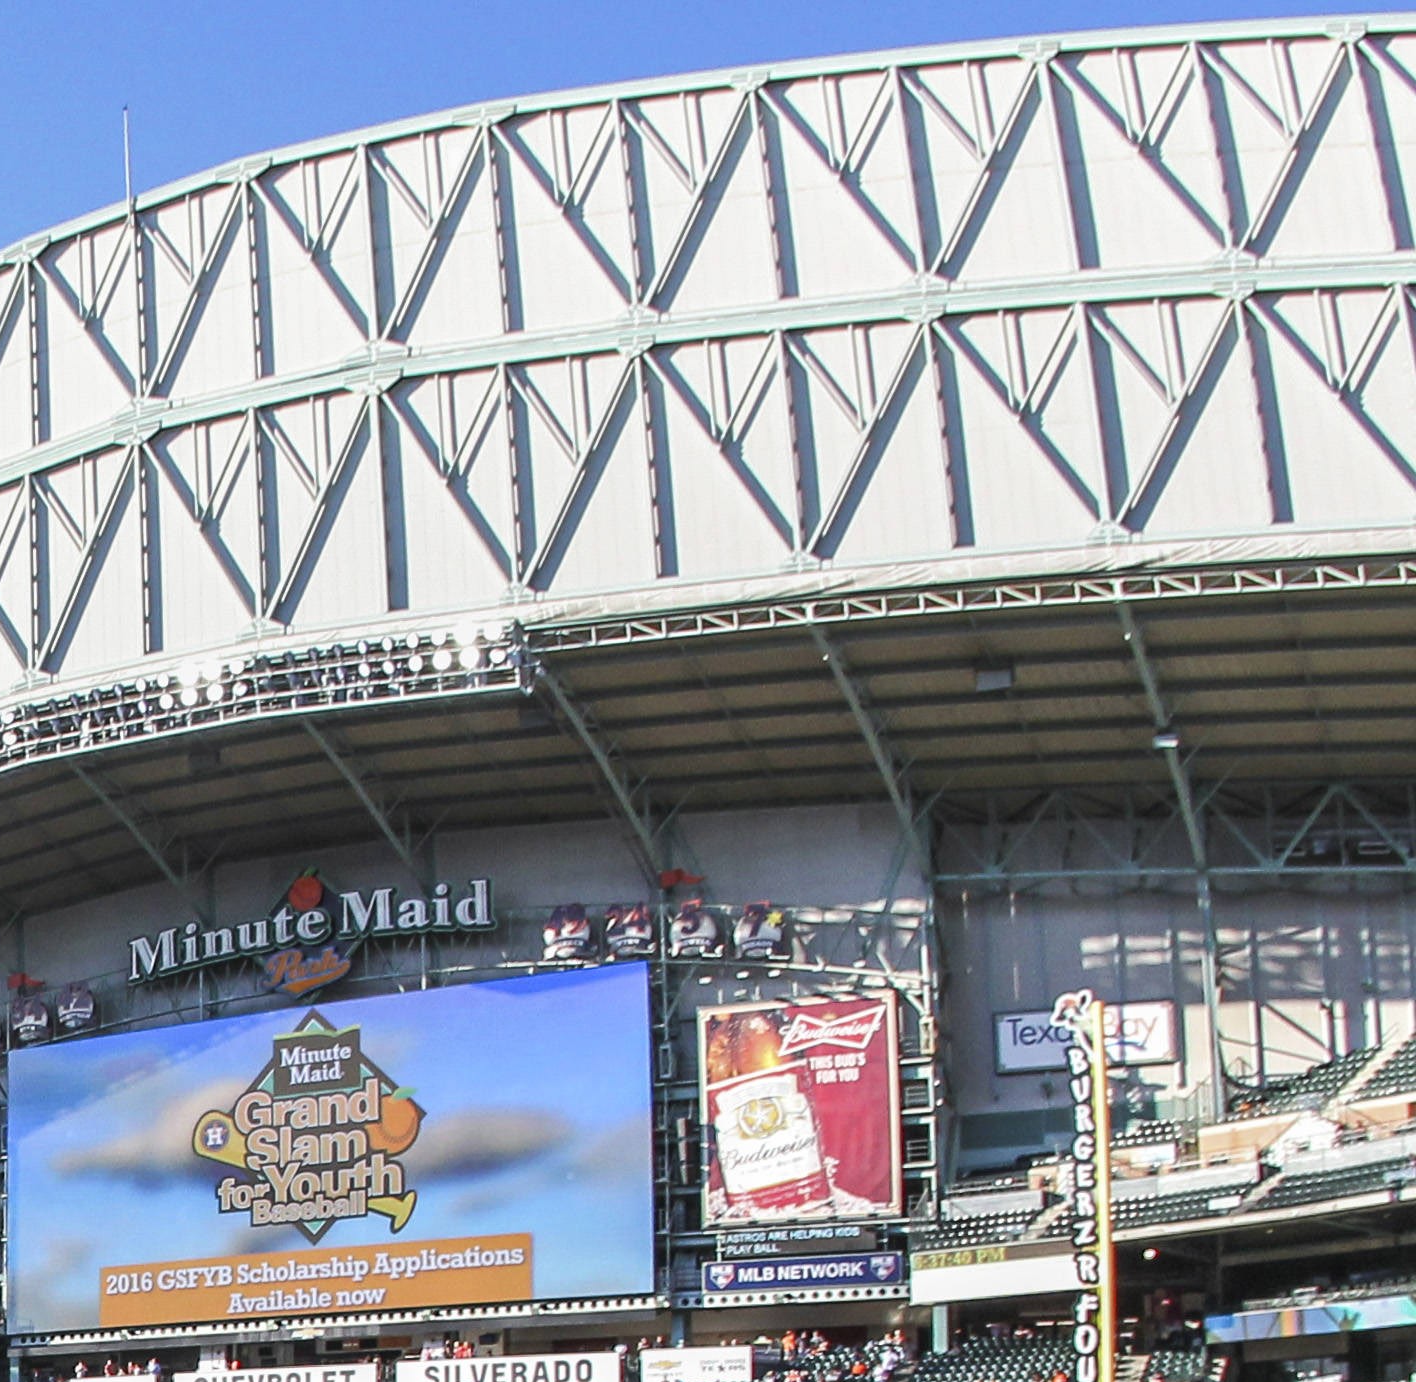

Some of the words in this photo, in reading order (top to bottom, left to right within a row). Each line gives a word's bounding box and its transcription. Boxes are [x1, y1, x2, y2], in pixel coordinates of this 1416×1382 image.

[128, 907, 326, 981] Minute
[339, 879, 492, 934] Maid
[779, 1019, 882, 1046] Budweiser
[280, 1043, 352, 1067] Minute
[809, 1055, 833, 1070] THIS
[835, 1053, 866, 1068] BUD'S
[290, 1062, 342, 1085] Maid
[816, 1070, 836, 1084] FOR
[838, 1068, 860, 1082] YOU
[234, 1078, 380, 1132] Grand
[246, 1126, 368, 1172] Slam
[1068, 1047, 1097, 1246] BURGERZ
[219, 1178, 270, 1211] for
[262, 1154, 403, 1202] Youth
[253, 1190, 366, 1225] Baseball
[790, 1228, 833, 1241] HELPING
[726, 1243, 755, 1255] PLAY
[977, 1247, 1007, 1264] PM
[106, 1271, 153, 1295] 2016
[157, 1265, 232, 1291] GSFYB
[236, 1250, 369, 1287] Scholarship
[373, 1247, 524, 1279] Applications
[738, 1266, 775, 1283] MLB
[777, 1262, 863, 1281] NETWORK
[227, 1289, 333, 1315] Available
[336, 1289, 385, 1307] now
